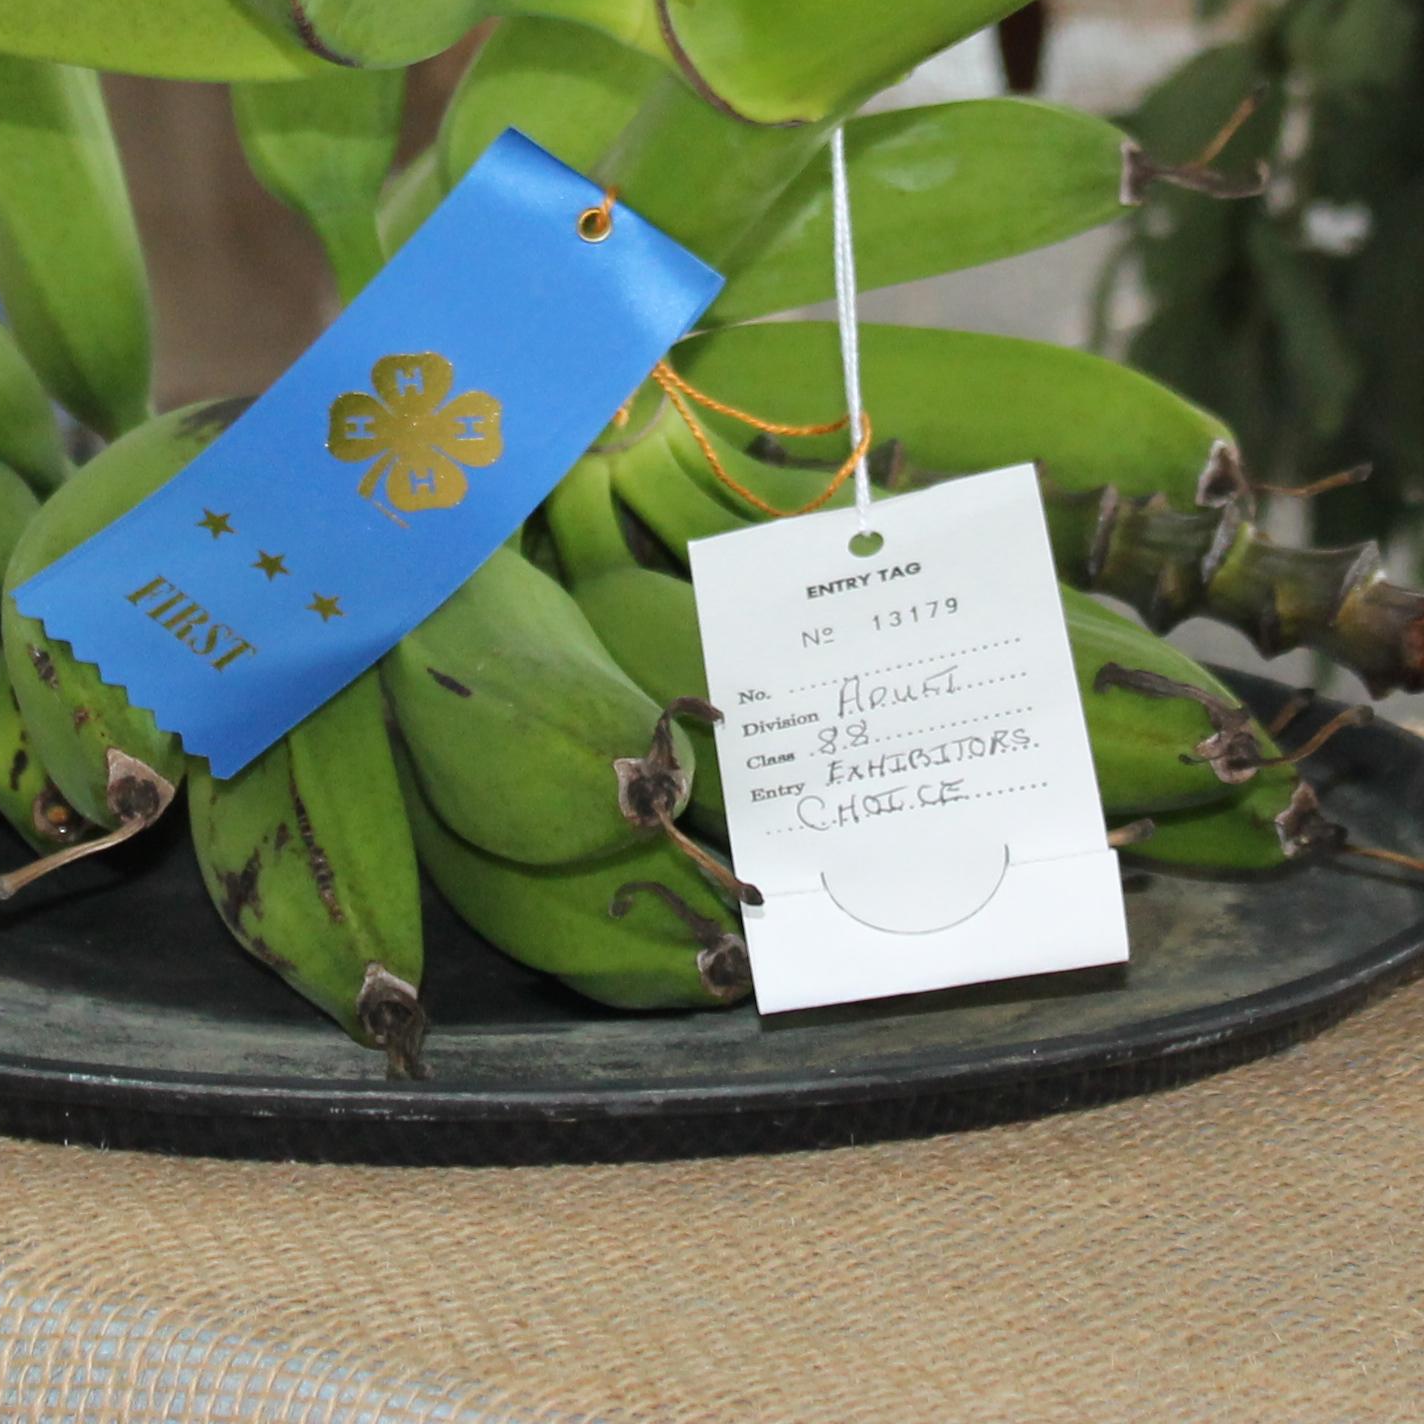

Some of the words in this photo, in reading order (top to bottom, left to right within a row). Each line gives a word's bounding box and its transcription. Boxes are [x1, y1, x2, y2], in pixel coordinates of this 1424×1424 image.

[394, 366, 425, 397] H
[343, 415, 375, 440] H
[453, 415, 485, 441] H
[408, 468, 437, 496] H
[806, 572, 872, 599] ENTRY
[876, 561, 922, 583] TAG
[125, 575, 259, 673] FIRST
[872, 596, 959, 631] 13179
[737, 688, 772, 705] No.
[742, 711, 820, 738] Division
[746, 751, 796, 770] Class
[750, 782, 806, 804] Entry
